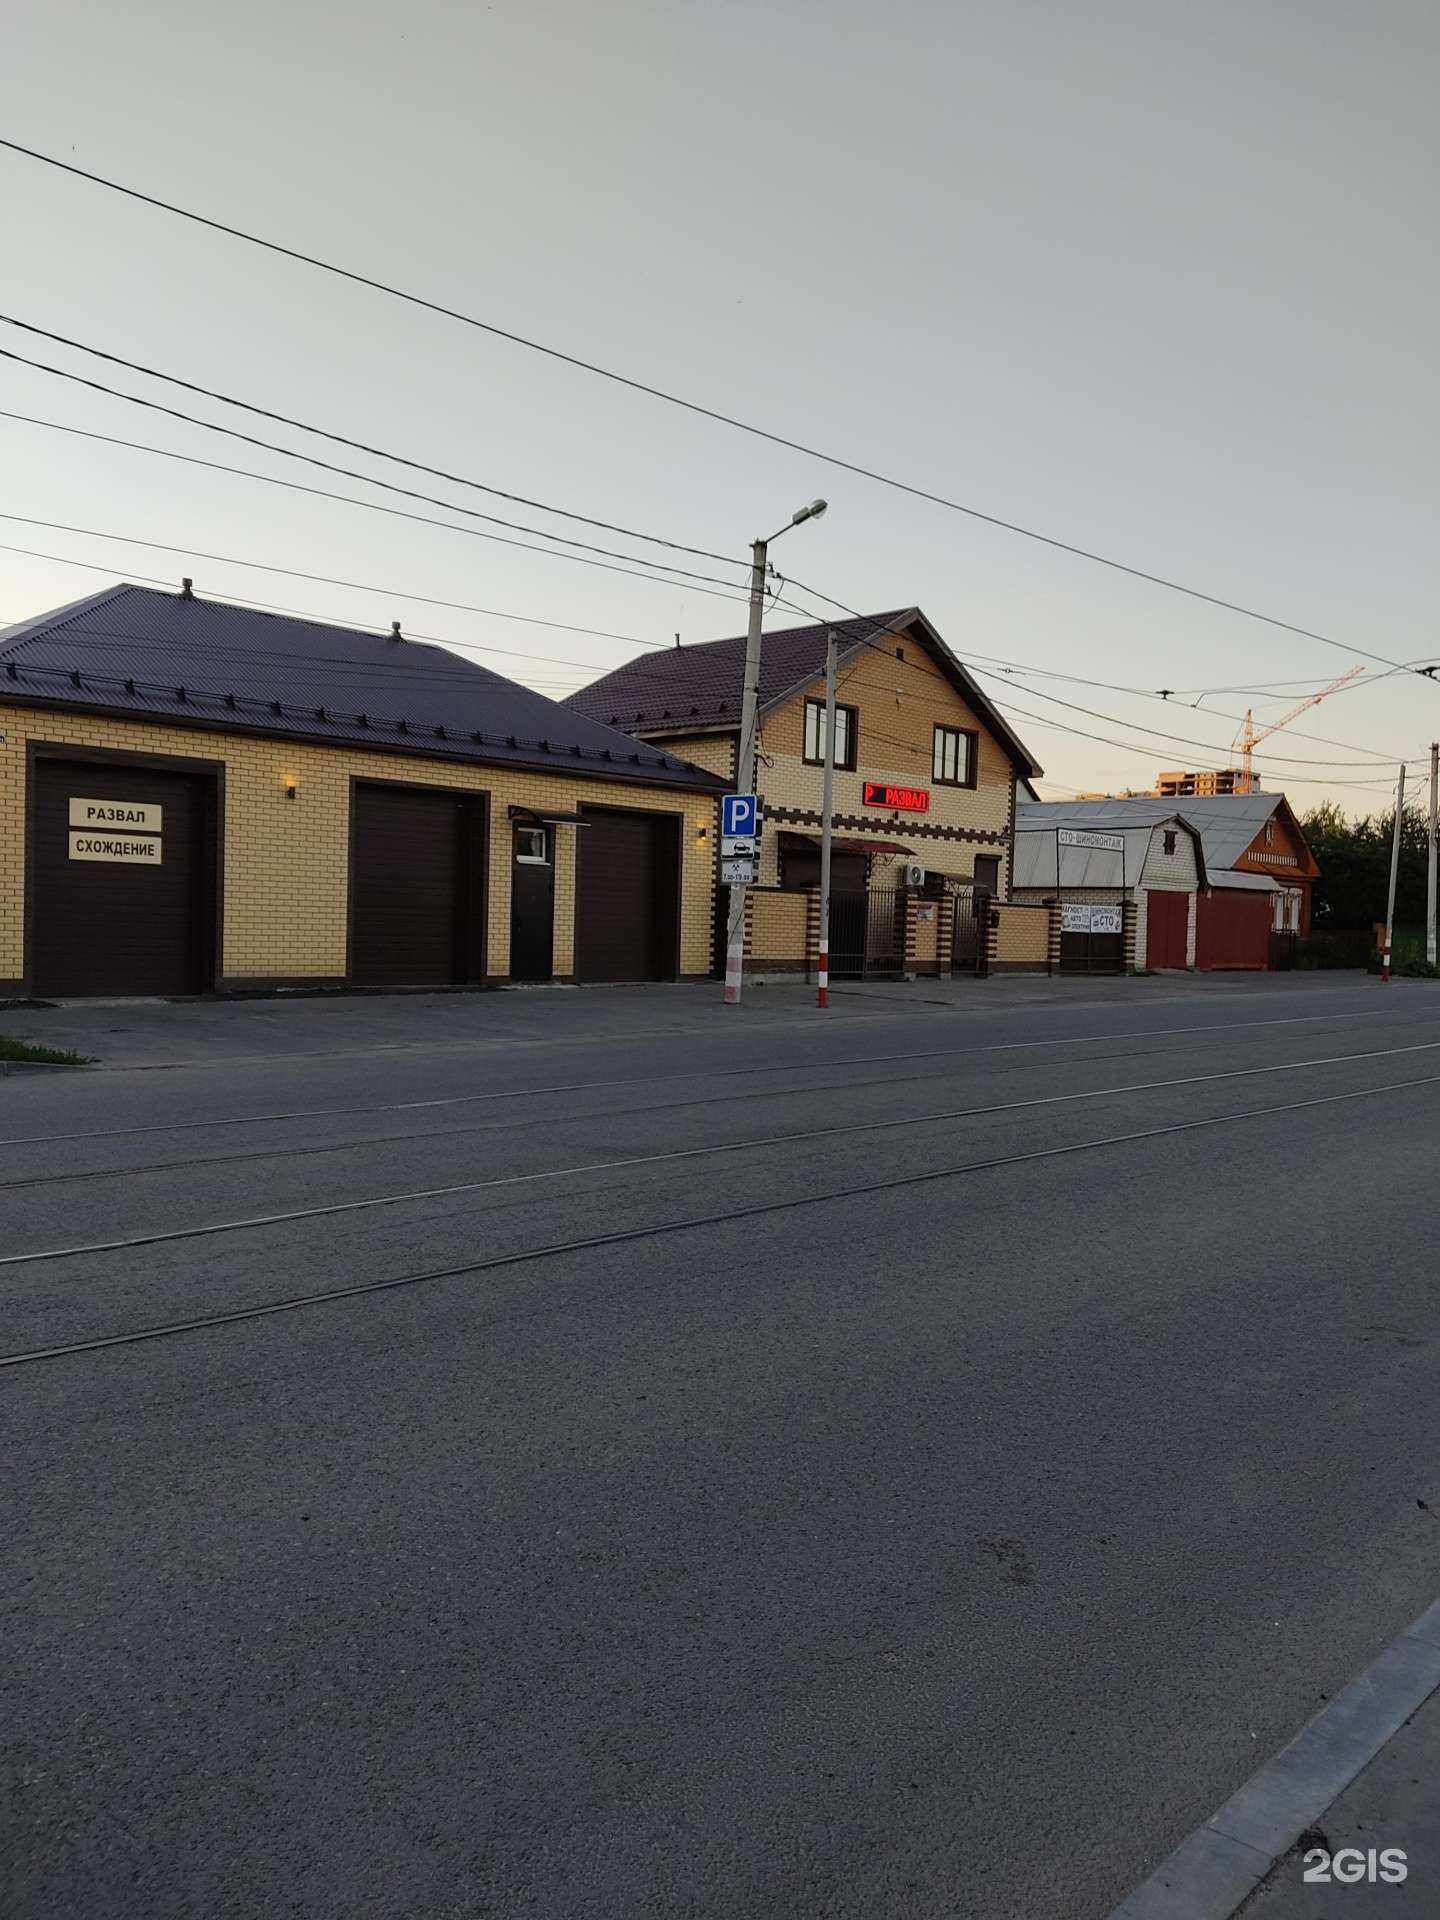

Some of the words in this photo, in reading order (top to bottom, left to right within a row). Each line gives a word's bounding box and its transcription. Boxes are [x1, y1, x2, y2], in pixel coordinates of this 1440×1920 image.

[886, 788, 926, 808] РАЗВАЛ
[87, 807, 145, 823] РАЗВАЛ
[731, 800, 750, 832] P
[76, 839, 155, 856] СХОЖДЕНИЕ
[1099, 915, 1114, 926] СТО
